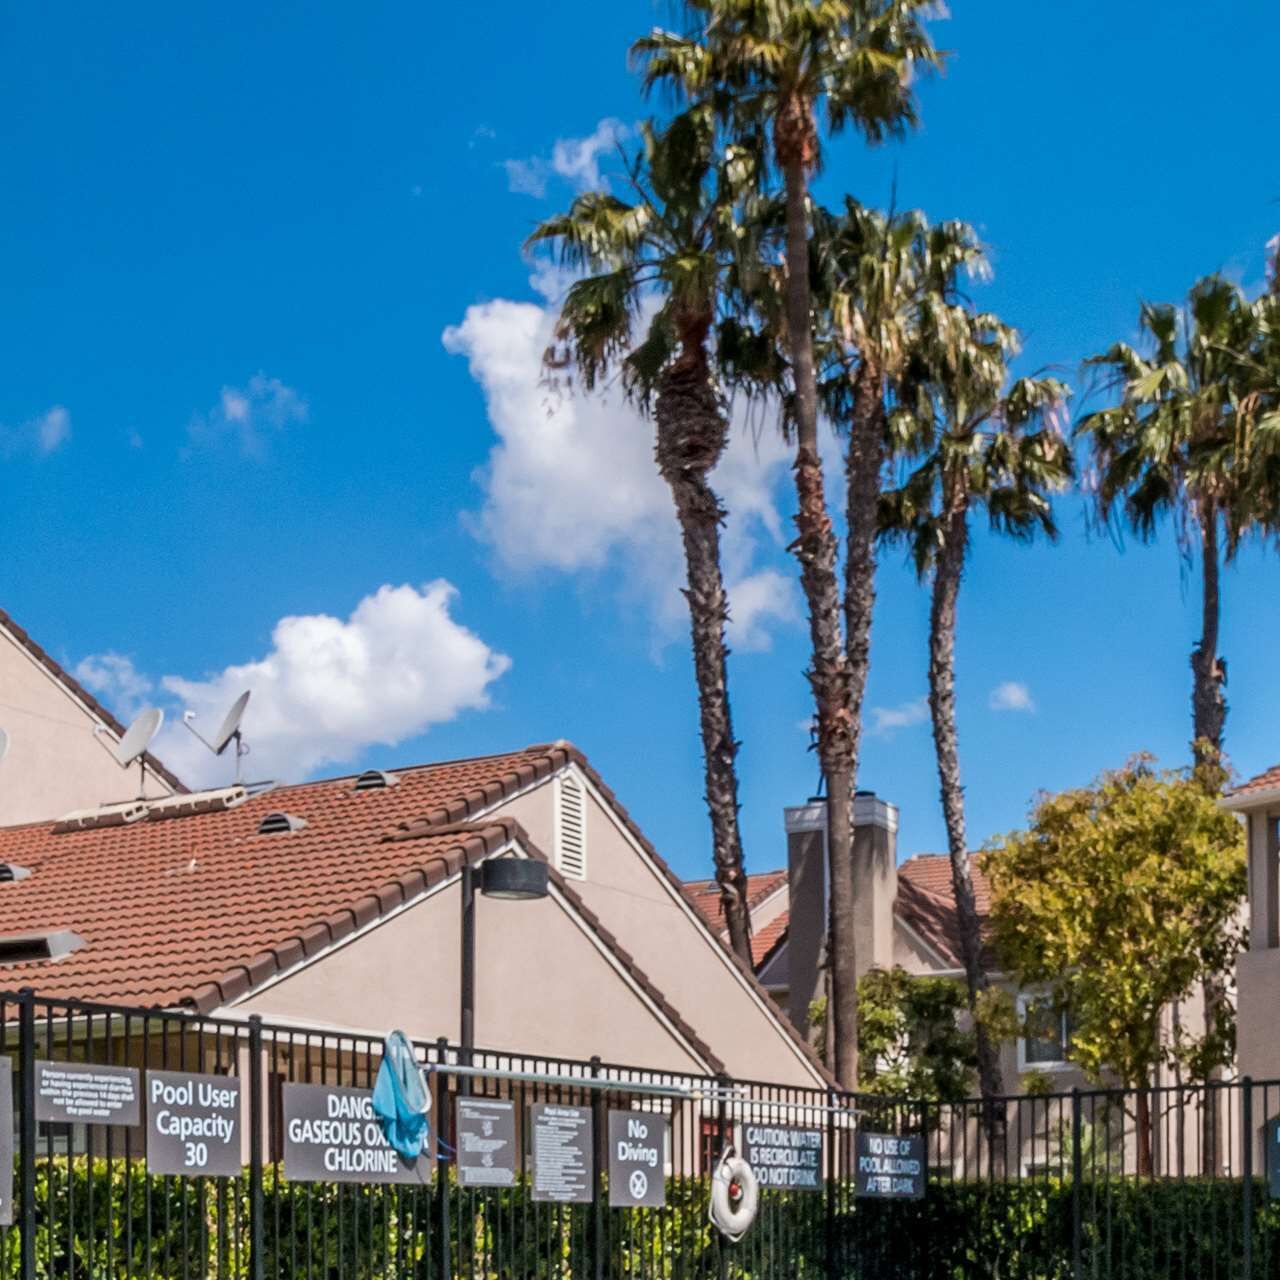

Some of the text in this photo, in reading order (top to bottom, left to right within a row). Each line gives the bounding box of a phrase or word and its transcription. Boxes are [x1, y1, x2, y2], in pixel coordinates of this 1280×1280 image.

[151, 1079, 238, 1108] Pool User
[328, 1094, 383, 1120] DANG
[156, 1110, 234, 1143] Capacity
[288, 1118, 361, 1146] GASEOUS
[628, 1119, 648, 1139] No
[746, 1127, 821, 1149] CAUTION: WATER
[184, 1142, 208, 1166] 30
[618, 1141, 658, 1167] Diving
[750, 1147, 759, 1164] IS
[870, 1138, 911, 1156] NO USE OF
[324, 1147, 398, 1173] CHLORINE
[859, 1156, 920, 1175] POOL ALLOWED
[752, 1166, 817, 1186] DO NOT DRINK
[866, 1176, 914, 1194] AFTER DARK
